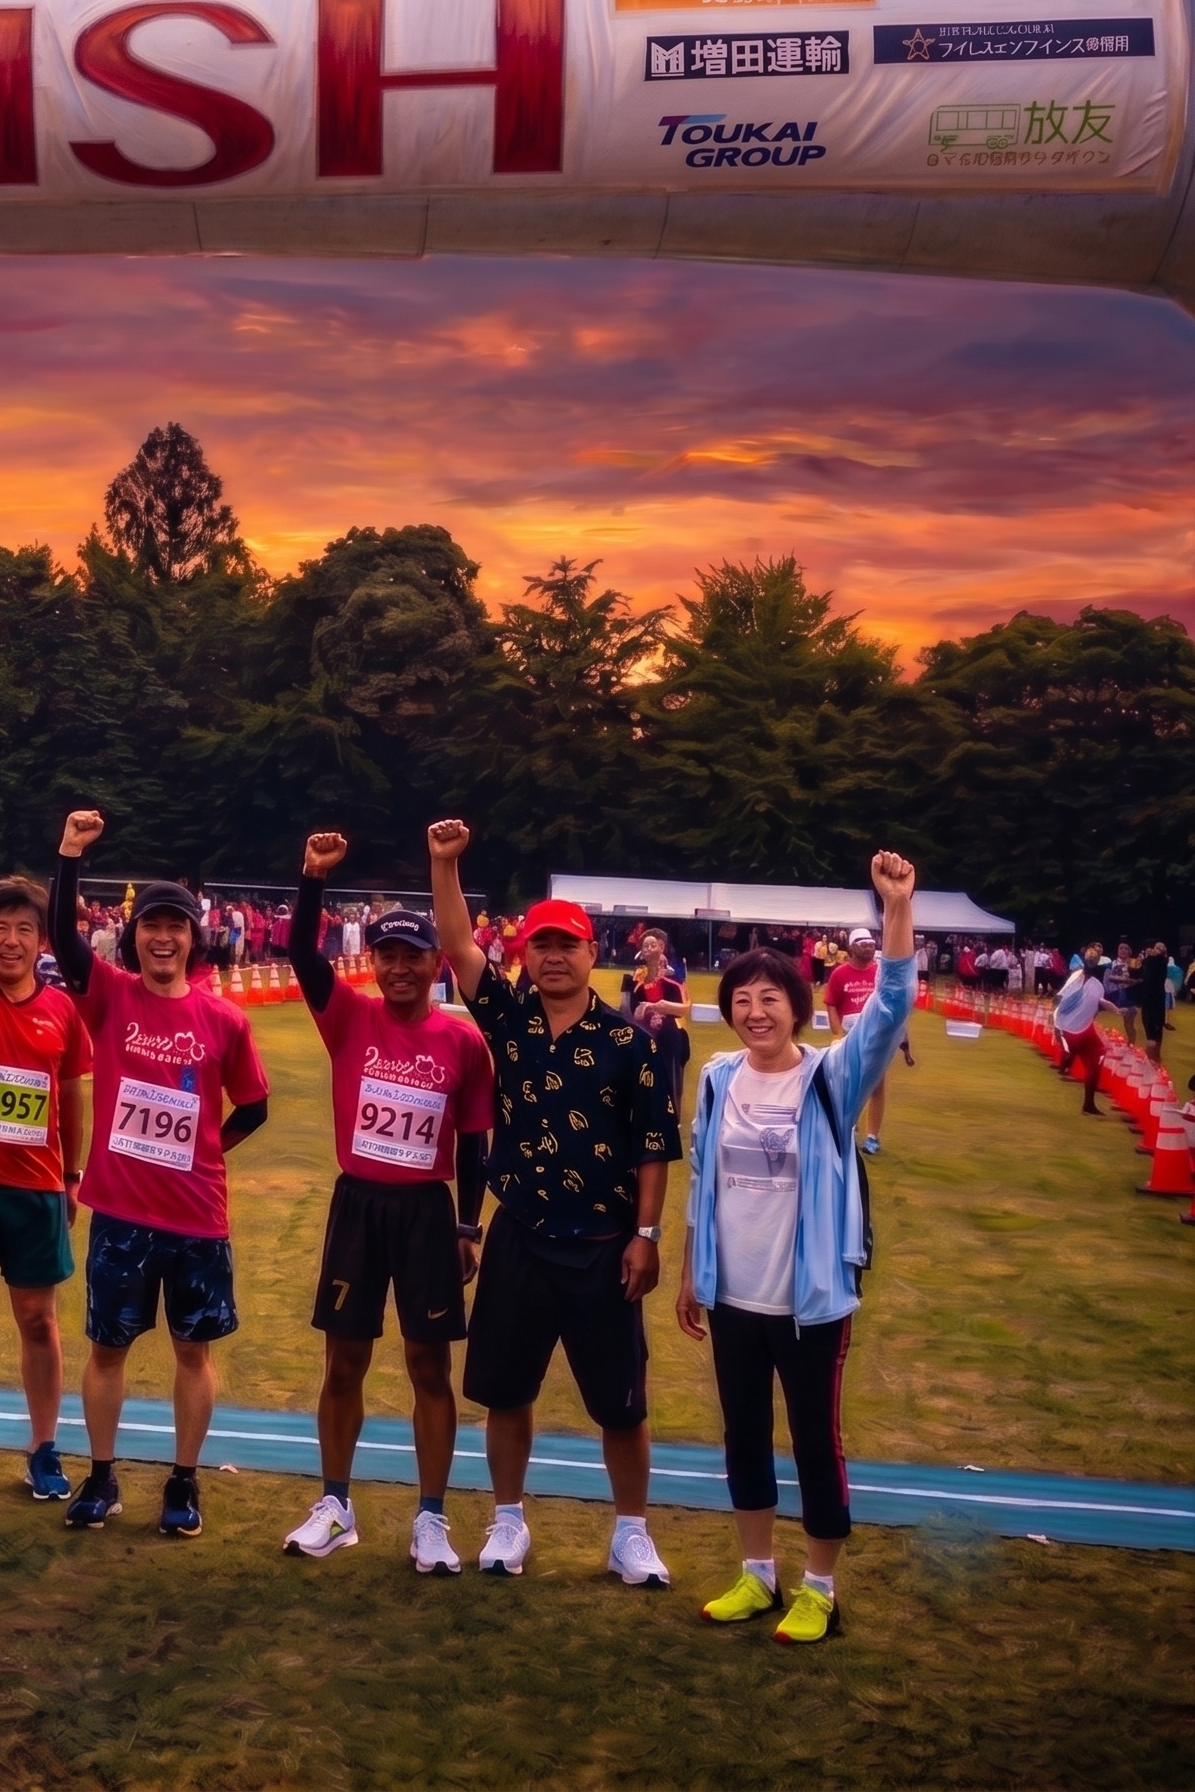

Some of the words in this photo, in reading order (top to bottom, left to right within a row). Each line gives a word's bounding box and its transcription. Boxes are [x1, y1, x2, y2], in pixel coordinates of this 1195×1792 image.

[691, 35, 842, 76] 増田運輸
[658, 114, 818, 145] TOUKAI
[685, 145, 827, 167] GROUP
[118, 1102, 192, 1143] 7196
[360, 1102, 435, 1144] 9214
[332, 1279, 350, 1311] 7
